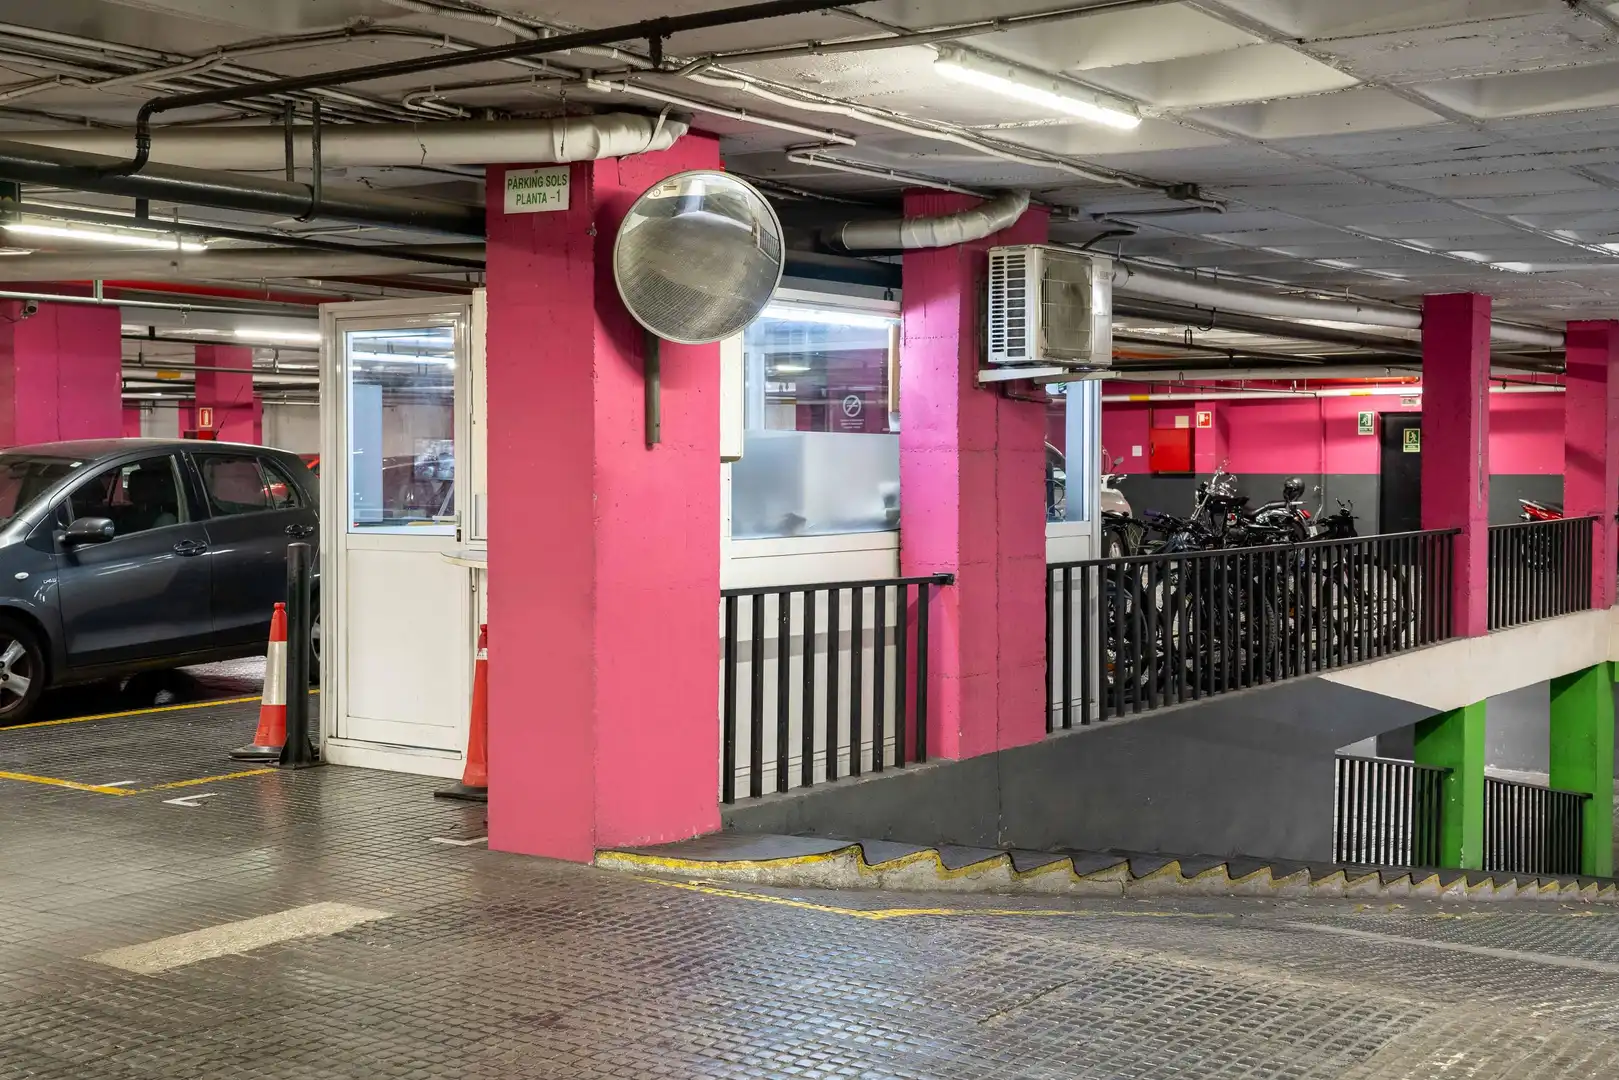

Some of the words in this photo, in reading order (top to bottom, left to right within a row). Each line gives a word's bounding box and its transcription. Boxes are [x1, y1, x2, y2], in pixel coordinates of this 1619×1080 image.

[545, 174, 568, 187] SOLS
[516, 192, 547, 206] PLANTA
[550, 189, 561, 202] -1
